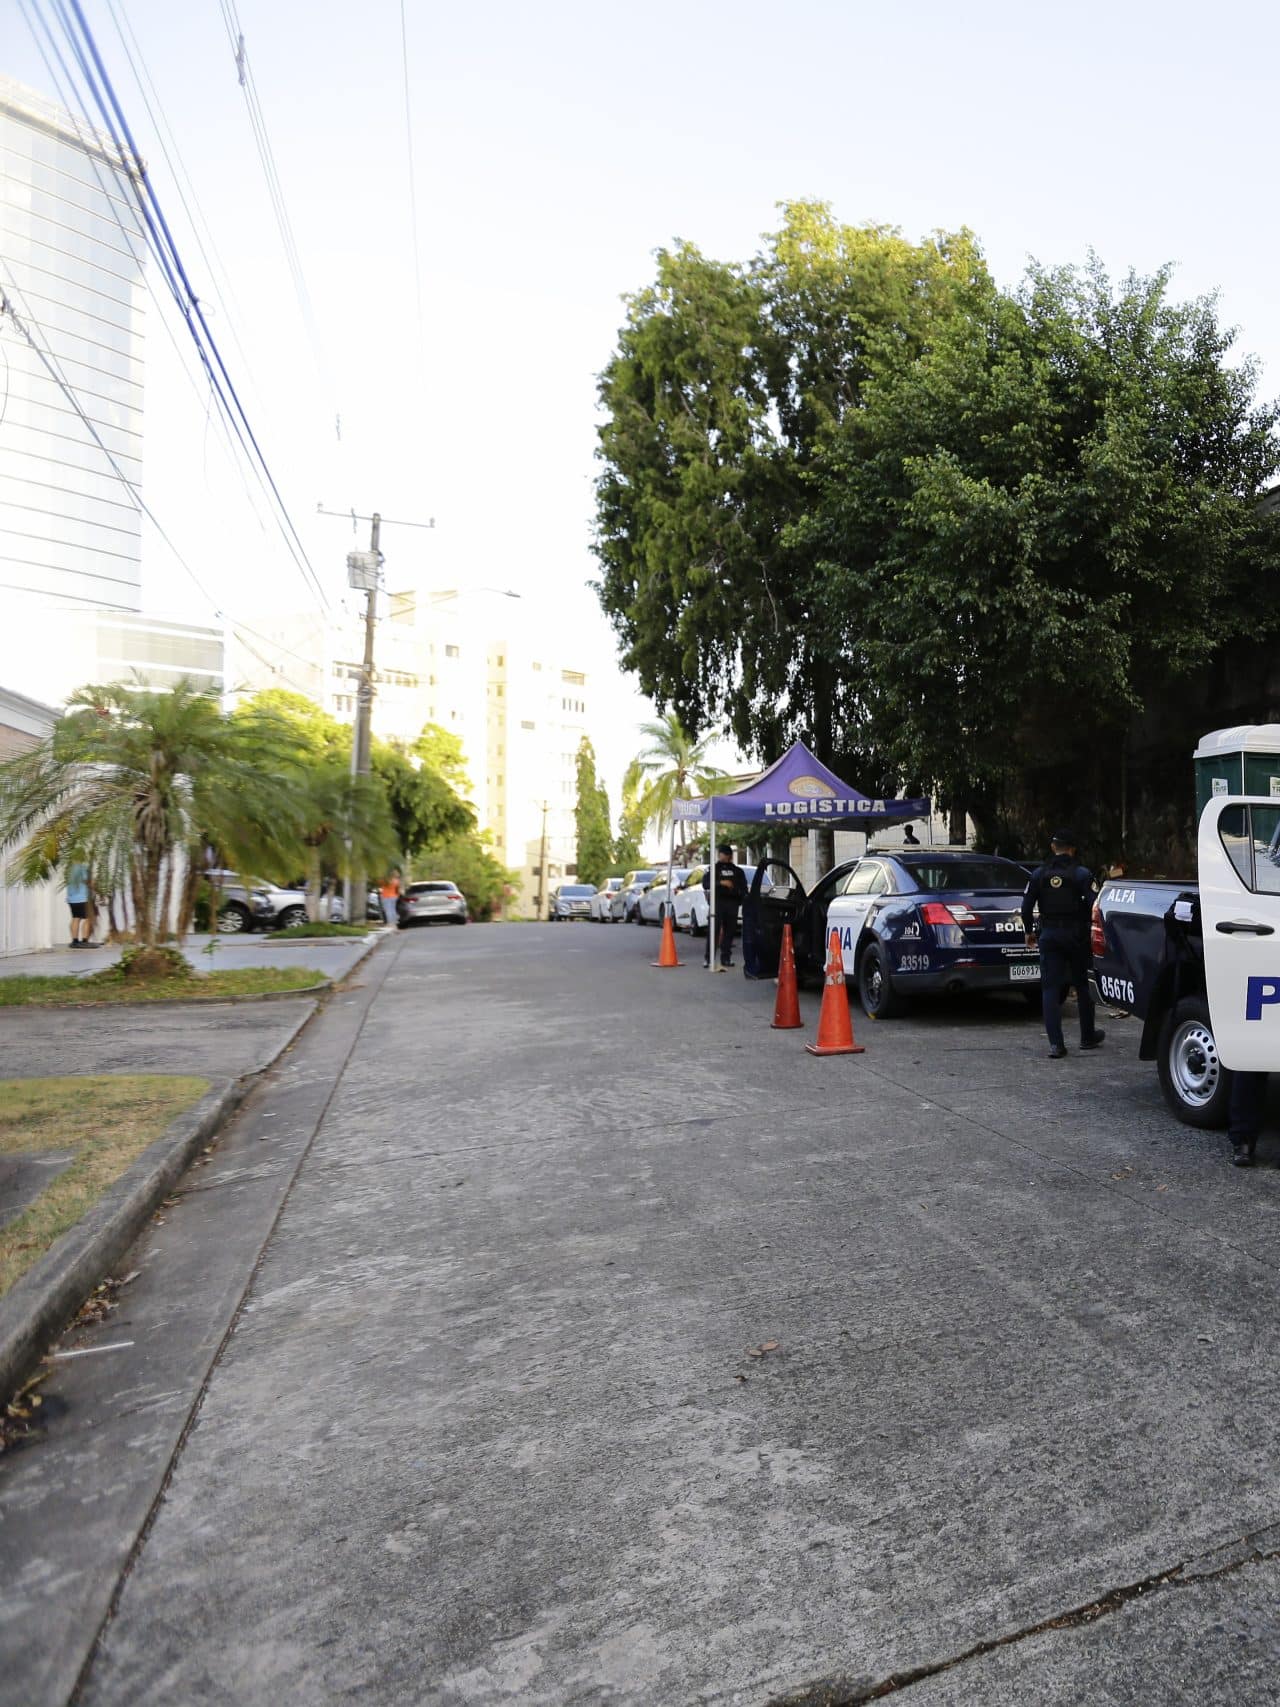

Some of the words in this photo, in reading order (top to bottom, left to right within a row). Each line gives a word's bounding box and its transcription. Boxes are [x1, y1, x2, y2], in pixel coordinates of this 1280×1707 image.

[764, 799, 886, 816] LOGÍSTICA
[1107, 888, 1136, 904] ALFA
[901, 954, 930, 971] 83519
[1101, 975, 1135, 1004] 85676
